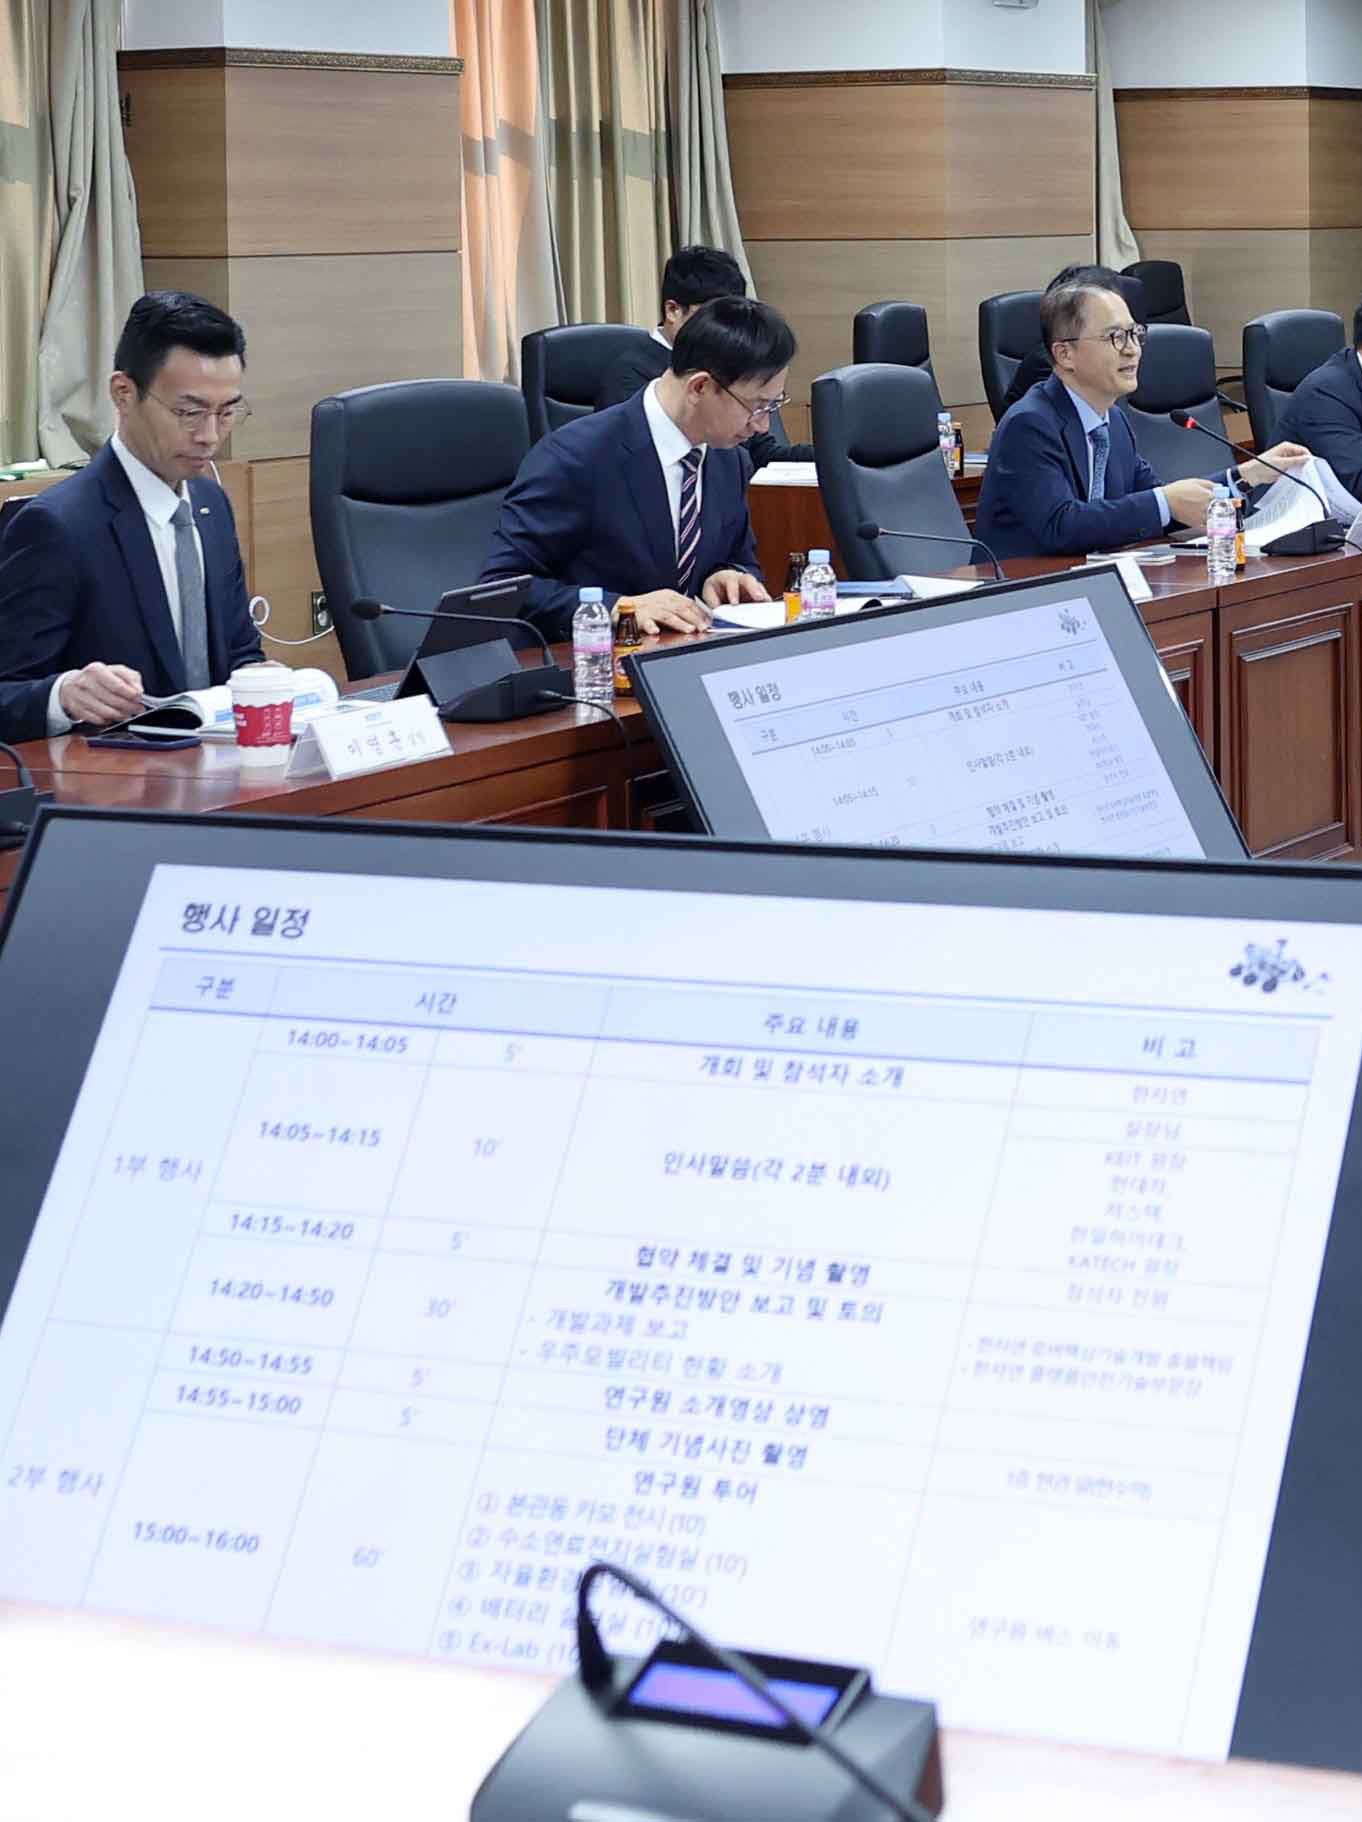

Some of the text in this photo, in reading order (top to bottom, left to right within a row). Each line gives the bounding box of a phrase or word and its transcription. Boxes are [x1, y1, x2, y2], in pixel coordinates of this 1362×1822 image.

[180, 900, 311, 940] 행사 일정
[195, 975, 235, 1001] 구분
[415, 989, 458, 1015] 시간
[763, 1012, 861, 1041] 주요 내용
[1141, 1035, 1198, 1060] 비 고
[699, 1053, 905, 1090] 개회 및 참석자 소개
[113, 1153, 205, 1186] 1부 행사
[791, 1161, 827, 1188] 2분
[838, 1162, 892, 1192] 내외)
[636, 1244, 872, 1288] 협약 체결 및 기념 촬영
[605, 1278, 884, 1325] 개발추진방안 보고 및 토의
[545, 1308, 690, 1340] 개발과제 보고
[536, 1340, 674, 1376] 우주모빌리티
[735, 1360, 785, 1385] 소개
[604, 1385, 832, 1430] 연구원 소개영상 상영
[604, 1424, 810, 1470] 단체 기념사진 촬영
[7, 1462, 106, 1498] 2부 행사
[633, 1468, 759, 1506] 연구원 투어
